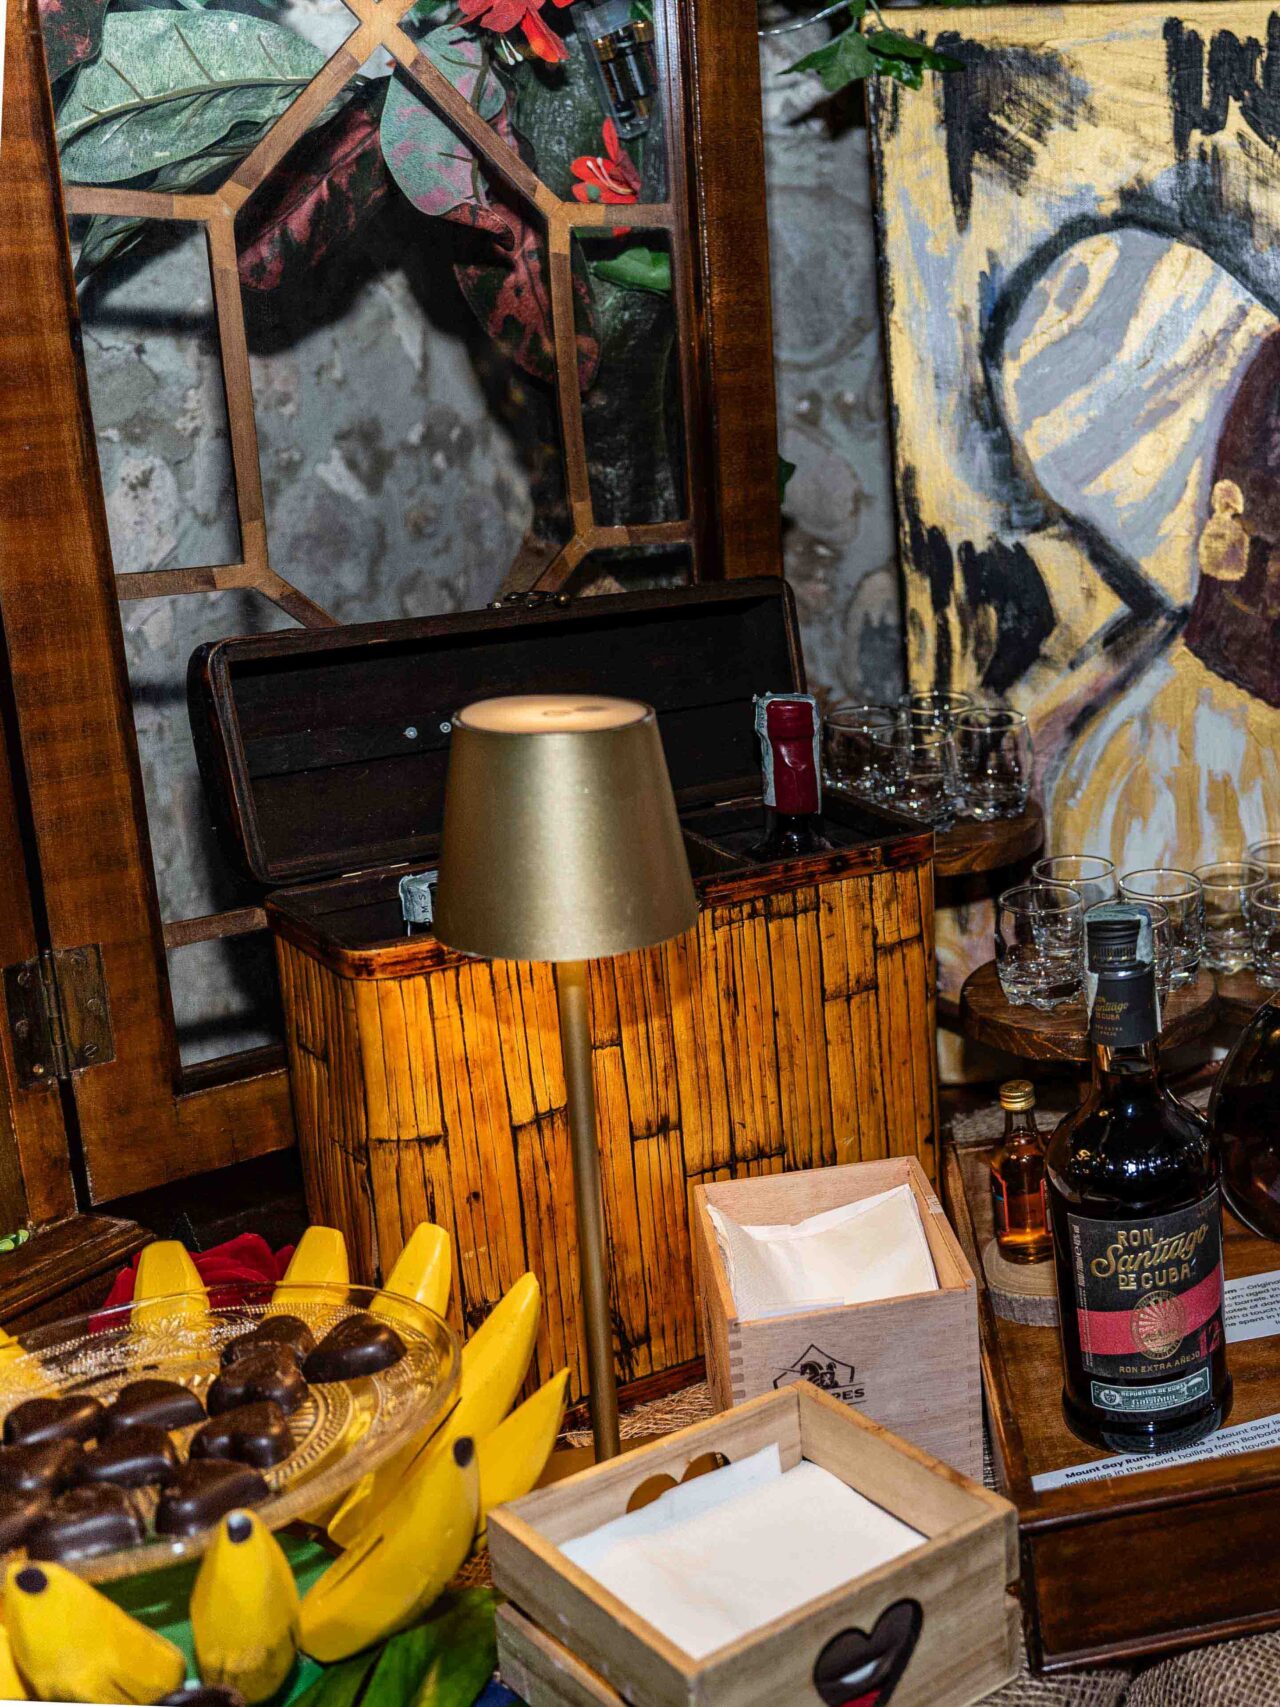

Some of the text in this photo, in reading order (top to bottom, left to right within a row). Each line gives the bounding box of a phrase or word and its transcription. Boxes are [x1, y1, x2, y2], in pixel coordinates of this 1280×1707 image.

[1090, 1223, 1210, 1278] Santiago
[1117, 1228, 1155, 1248] RON
[1118, 1263, 1191, 1290] DE CUBA
[1198, 1320, 1222, 1358] 12
[1119, 1350, 1201, 1374] RON EXTRA AÑEJO
[1066, 1466, 1100, 1478] Mount
[1101, 1461, 1124, 1471] Gay
[1126, 1455, 1154, 1465] Rum,
[1217, 1428, 1249, 1442] Mount
[1250, 1422, 1271, 1433] Gay
[1145, 1457, 1178, 1468] world,
[1214, 1439, 1239, 1450] from
[1241, 1438, 1276, 1452] flavors
